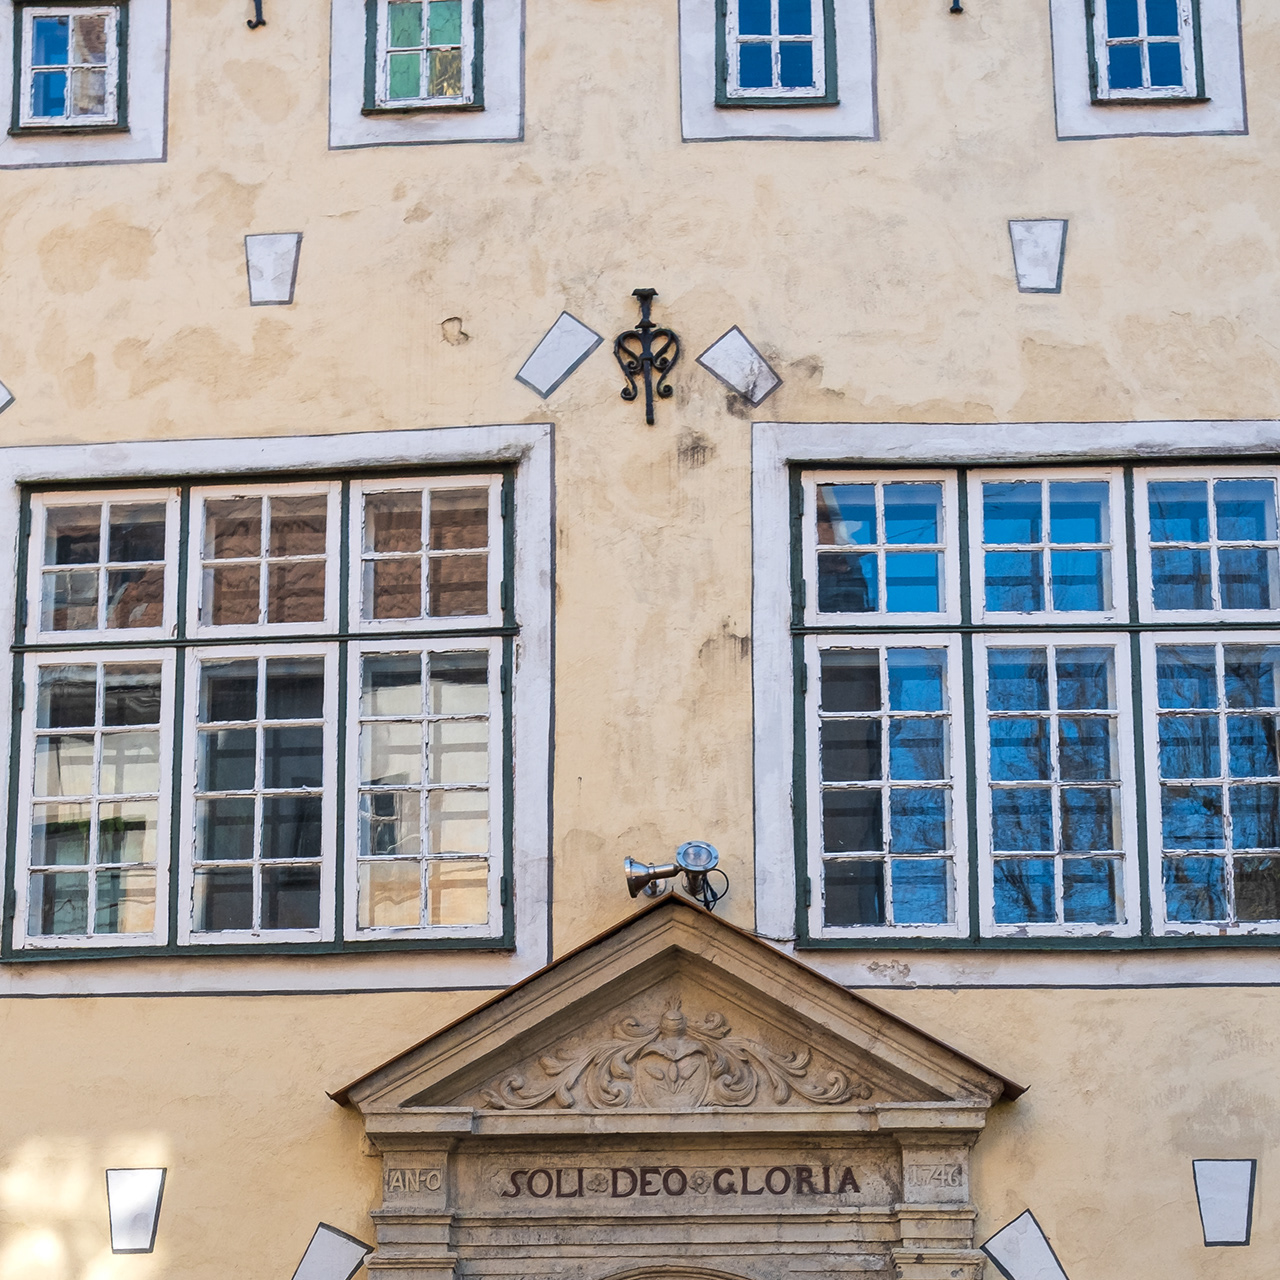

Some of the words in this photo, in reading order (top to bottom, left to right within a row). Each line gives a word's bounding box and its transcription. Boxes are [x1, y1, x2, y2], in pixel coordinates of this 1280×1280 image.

[501, 1168, 585, 1198] SOLI
[611, 1167, 688, 1198] DEO
[713, 1166, 861, 1196] GLORIA
